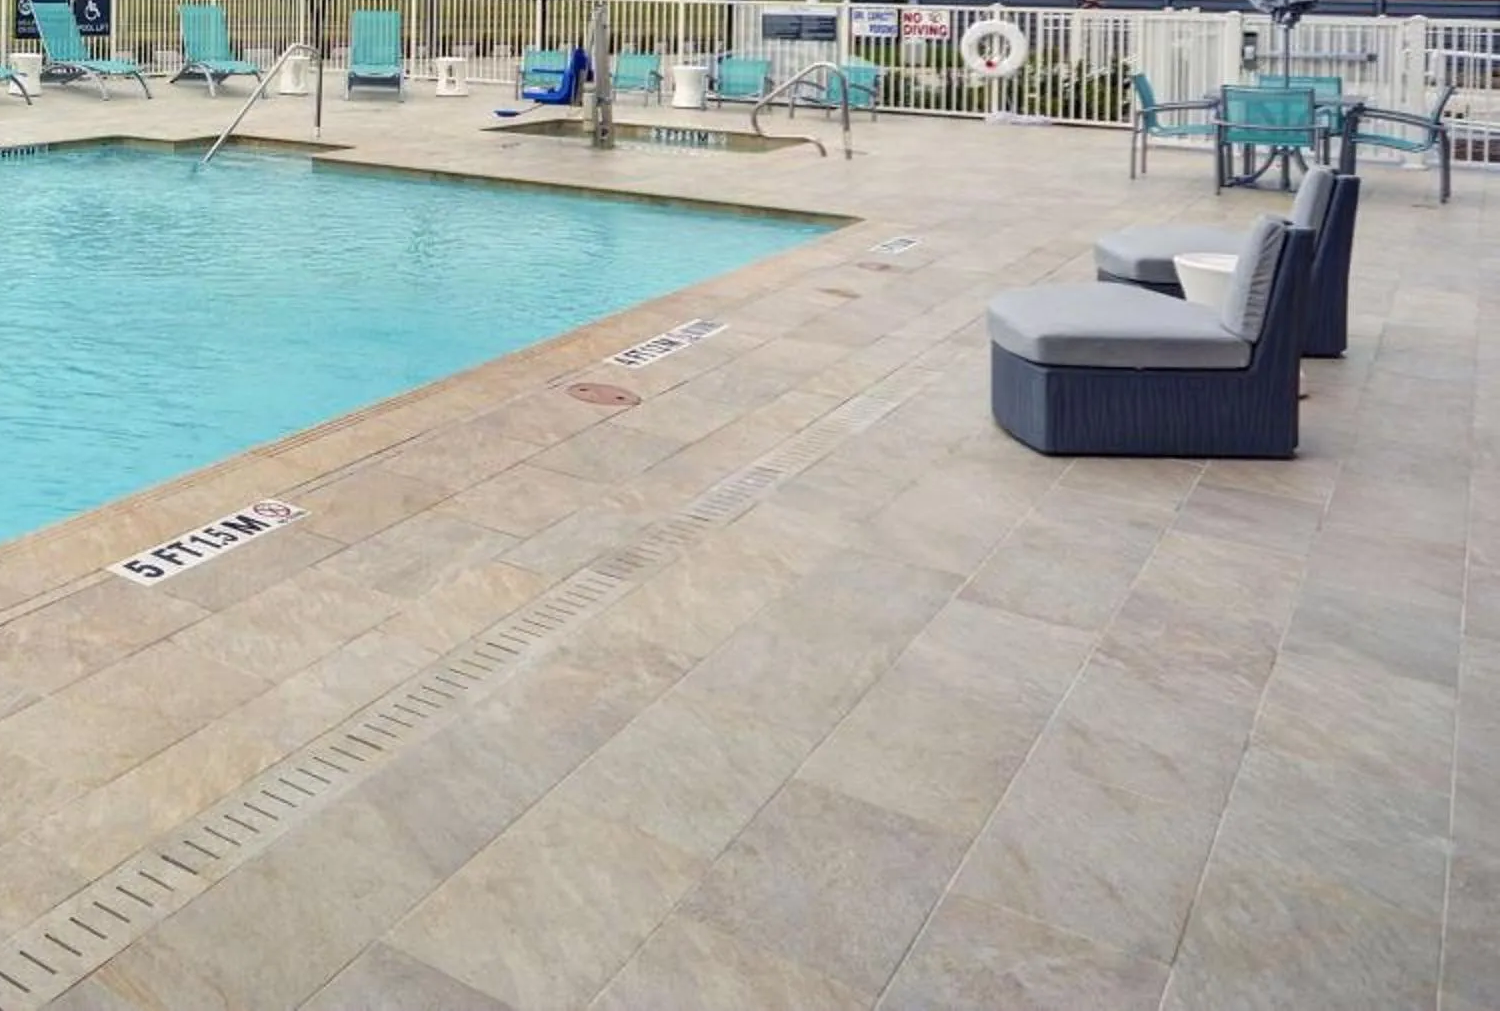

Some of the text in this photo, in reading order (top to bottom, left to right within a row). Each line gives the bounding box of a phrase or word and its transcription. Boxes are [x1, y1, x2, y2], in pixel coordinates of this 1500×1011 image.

[903, 12, 922, 22] NO
[903, 24, 947, 35] DIVING
[123, 560, 165, 578] 5
[150, 541, 203, 566] FT
